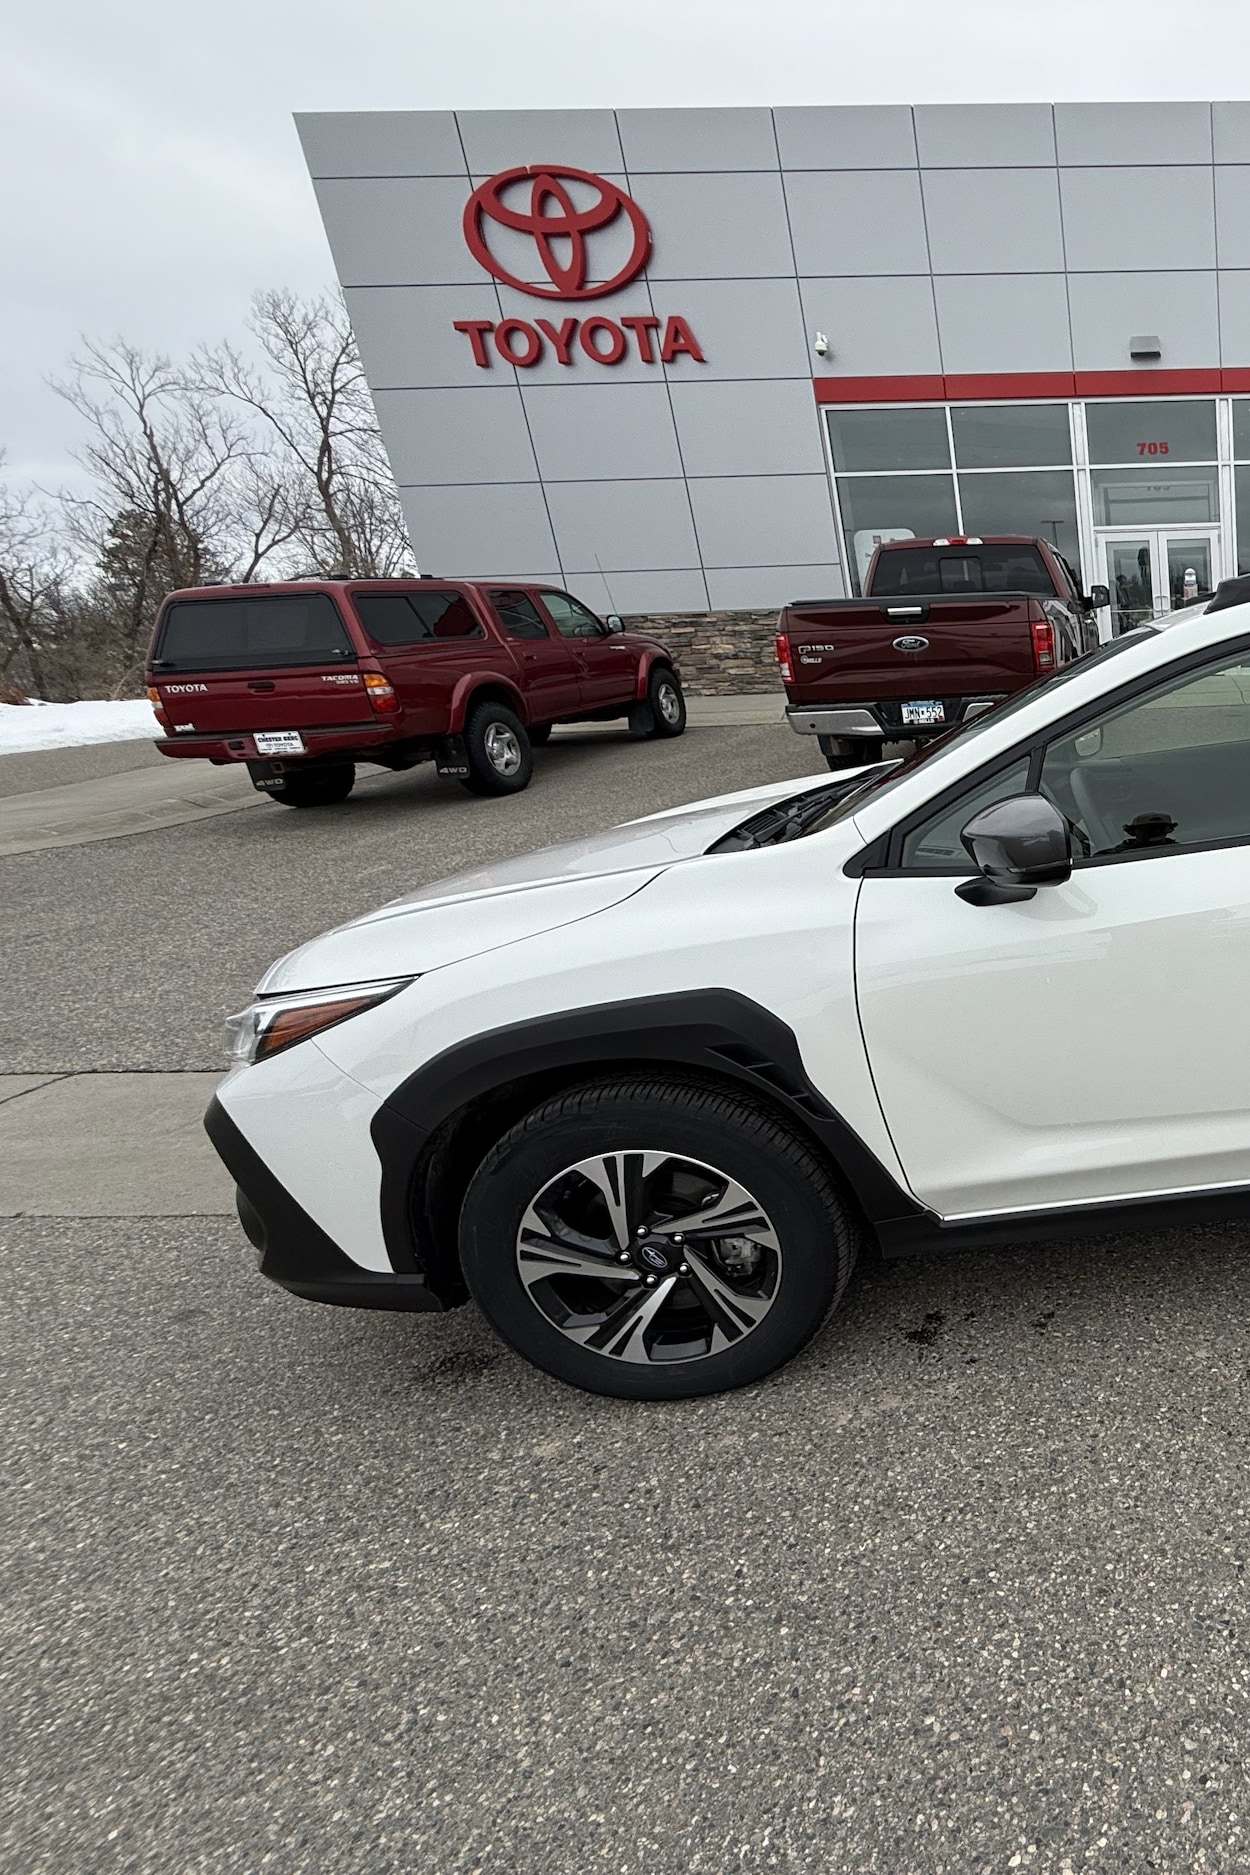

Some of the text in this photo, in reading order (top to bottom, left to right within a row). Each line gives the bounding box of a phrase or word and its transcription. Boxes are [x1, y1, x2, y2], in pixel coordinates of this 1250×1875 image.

[453, 316, 707, 368] TOYOTA
[1136, 441, 1169, 455] 705
[164, 684, 208, 693] TOYOTA
[439, 766, 467, 774] 4WD
[256, 778, 284, 786] 4WD
